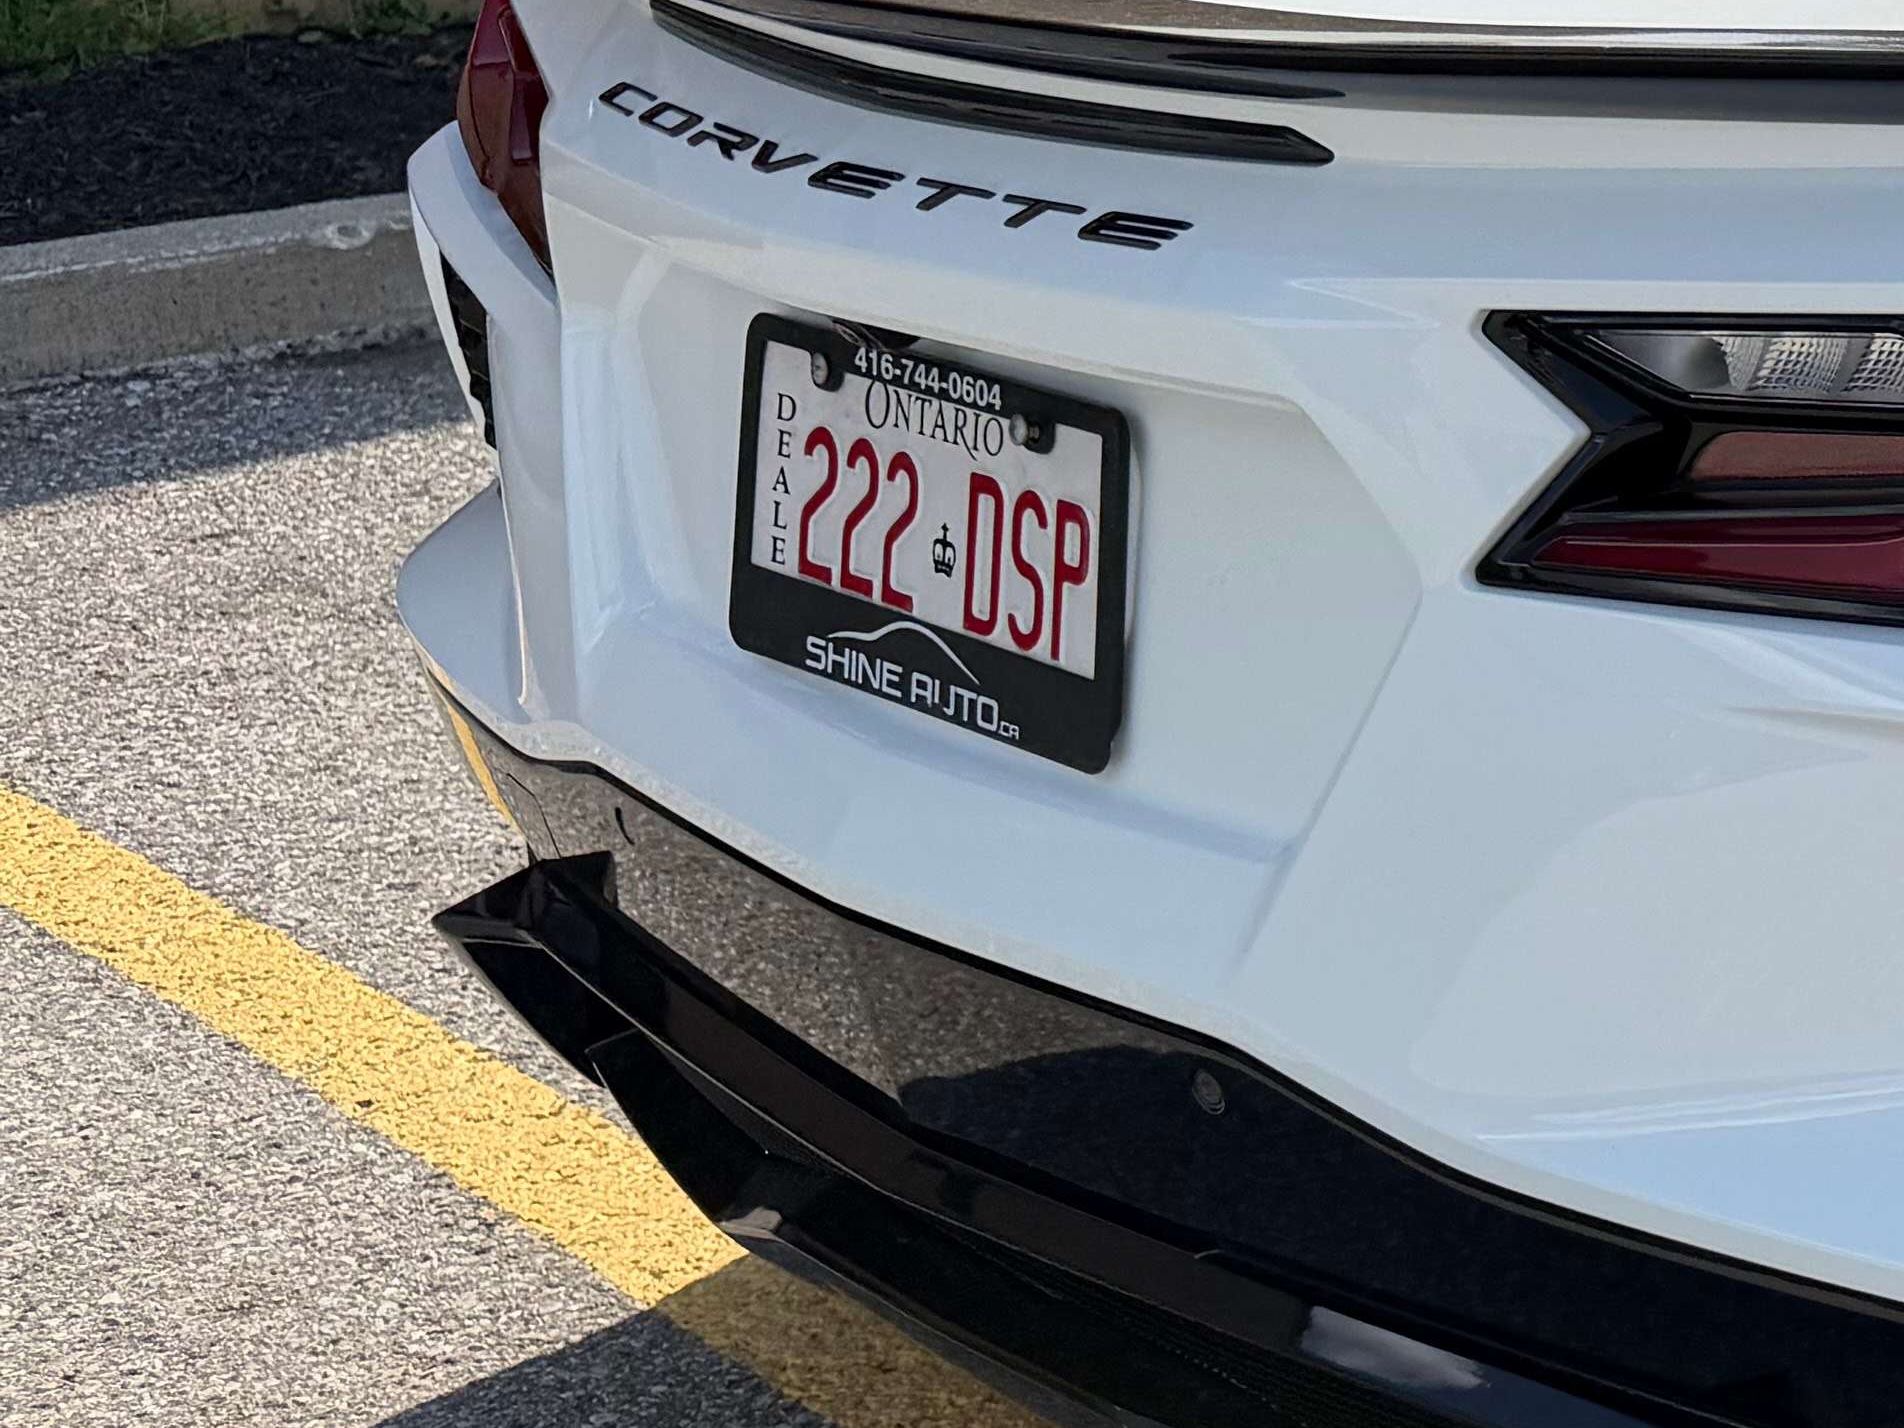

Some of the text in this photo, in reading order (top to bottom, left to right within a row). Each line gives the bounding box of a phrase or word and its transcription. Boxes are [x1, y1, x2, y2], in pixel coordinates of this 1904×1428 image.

[599, 82, 1195, 251] CORVETTE
[853, 347, 1001, 408] 416-744-0604
[865, 381, 1004, 461] ONTARIO
[770, 393, 796, 566] DEALE
[798, 426, 1089, 661] 222 DSP
[805, 635, 902, 697] SHINE
